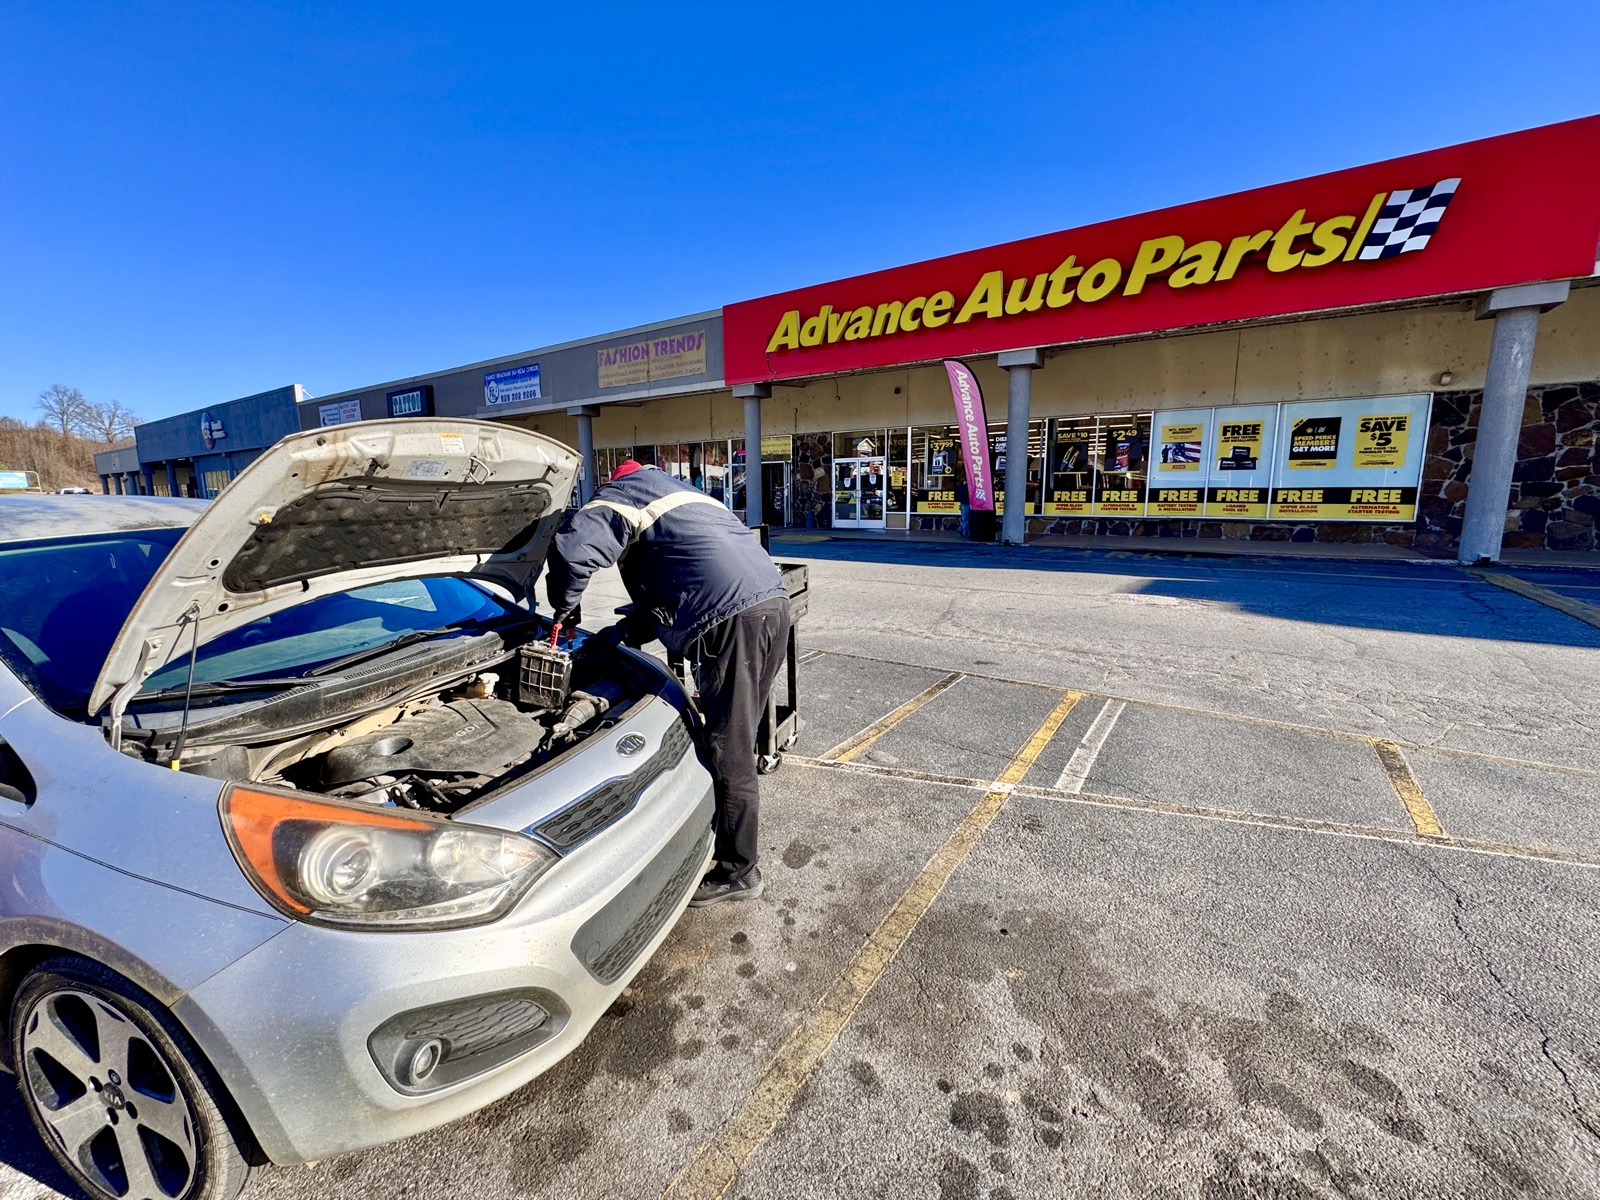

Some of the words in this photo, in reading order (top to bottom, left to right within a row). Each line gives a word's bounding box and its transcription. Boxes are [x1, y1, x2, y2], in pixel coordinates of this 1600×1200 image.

[765, 290, 954, 353] Advance
[953, 254, 1122, 325] Auto
[1123, 207, 1357, 296] Parts
[597, 343, 649, 367] FASHION
[653, 332, 704, 358] TRENDS
[955, 369, 974, 422] Advance
[1222, 424, 1261, 436] FREE
[1360, 420, 1406, 433] SAVE
[966, 423, 979, 455] Auto
[1293, 439, 1335, 447] MEMBERS
[1370, 432, 1392, 447] $5
[971, 455, 984, 489] Parts
[928, 491, 955, 501] FREE
[994, 491, 1005, 501] FR
[1053, 491, 1087, 502] FREE
[1102, 491, 1138, 502] FREE
[1159, 490, 1199, 502] FREE
[1216, 490, 1259, 502] FREE
[1277, 489, 1324, 502] FREE
[1349, 489, 1402, 503] FREE
[455, 724, 480, 737] GDI
[621, 735, 645, 753] KIA
[103, 1090, 122, 1106] KIA
